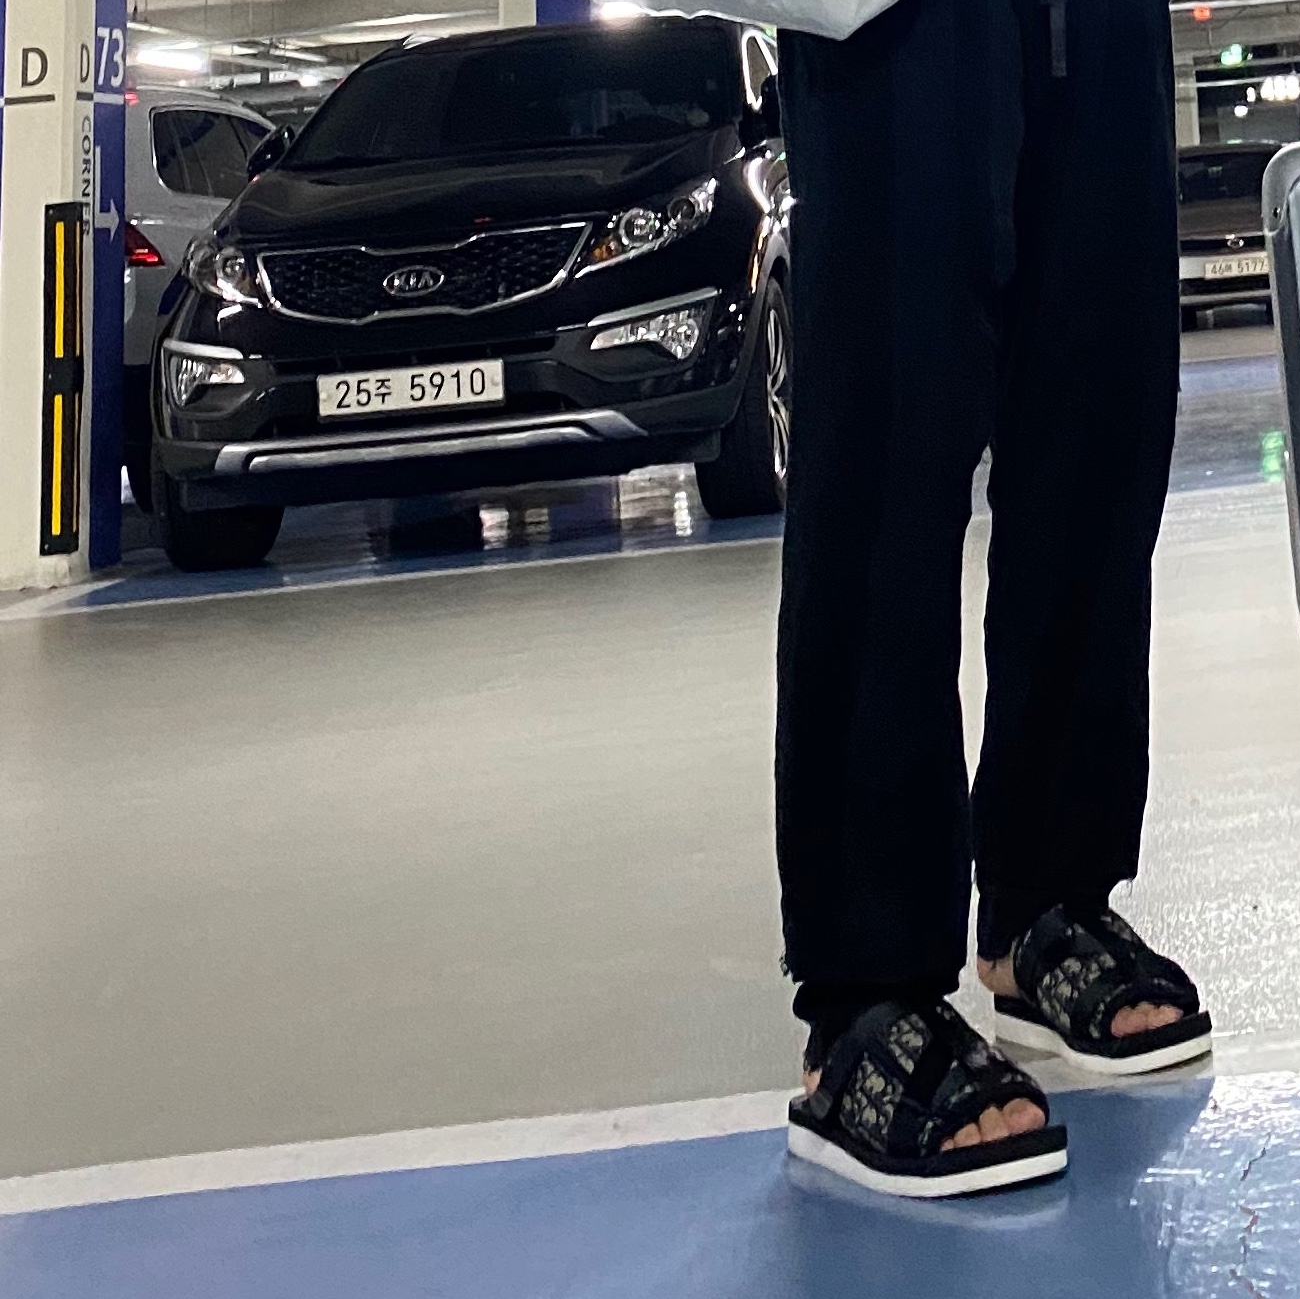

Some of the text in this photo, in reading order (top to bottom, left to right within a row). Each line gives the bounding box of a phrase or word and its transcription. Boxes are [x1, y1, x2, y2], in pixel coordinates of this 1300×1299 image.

[21, 46, 49, 88] D
[79, 26, 125, 88] D 73
[393, 270, 434, 291] KIA
[335, 367, 486, 410] 25주 5910
